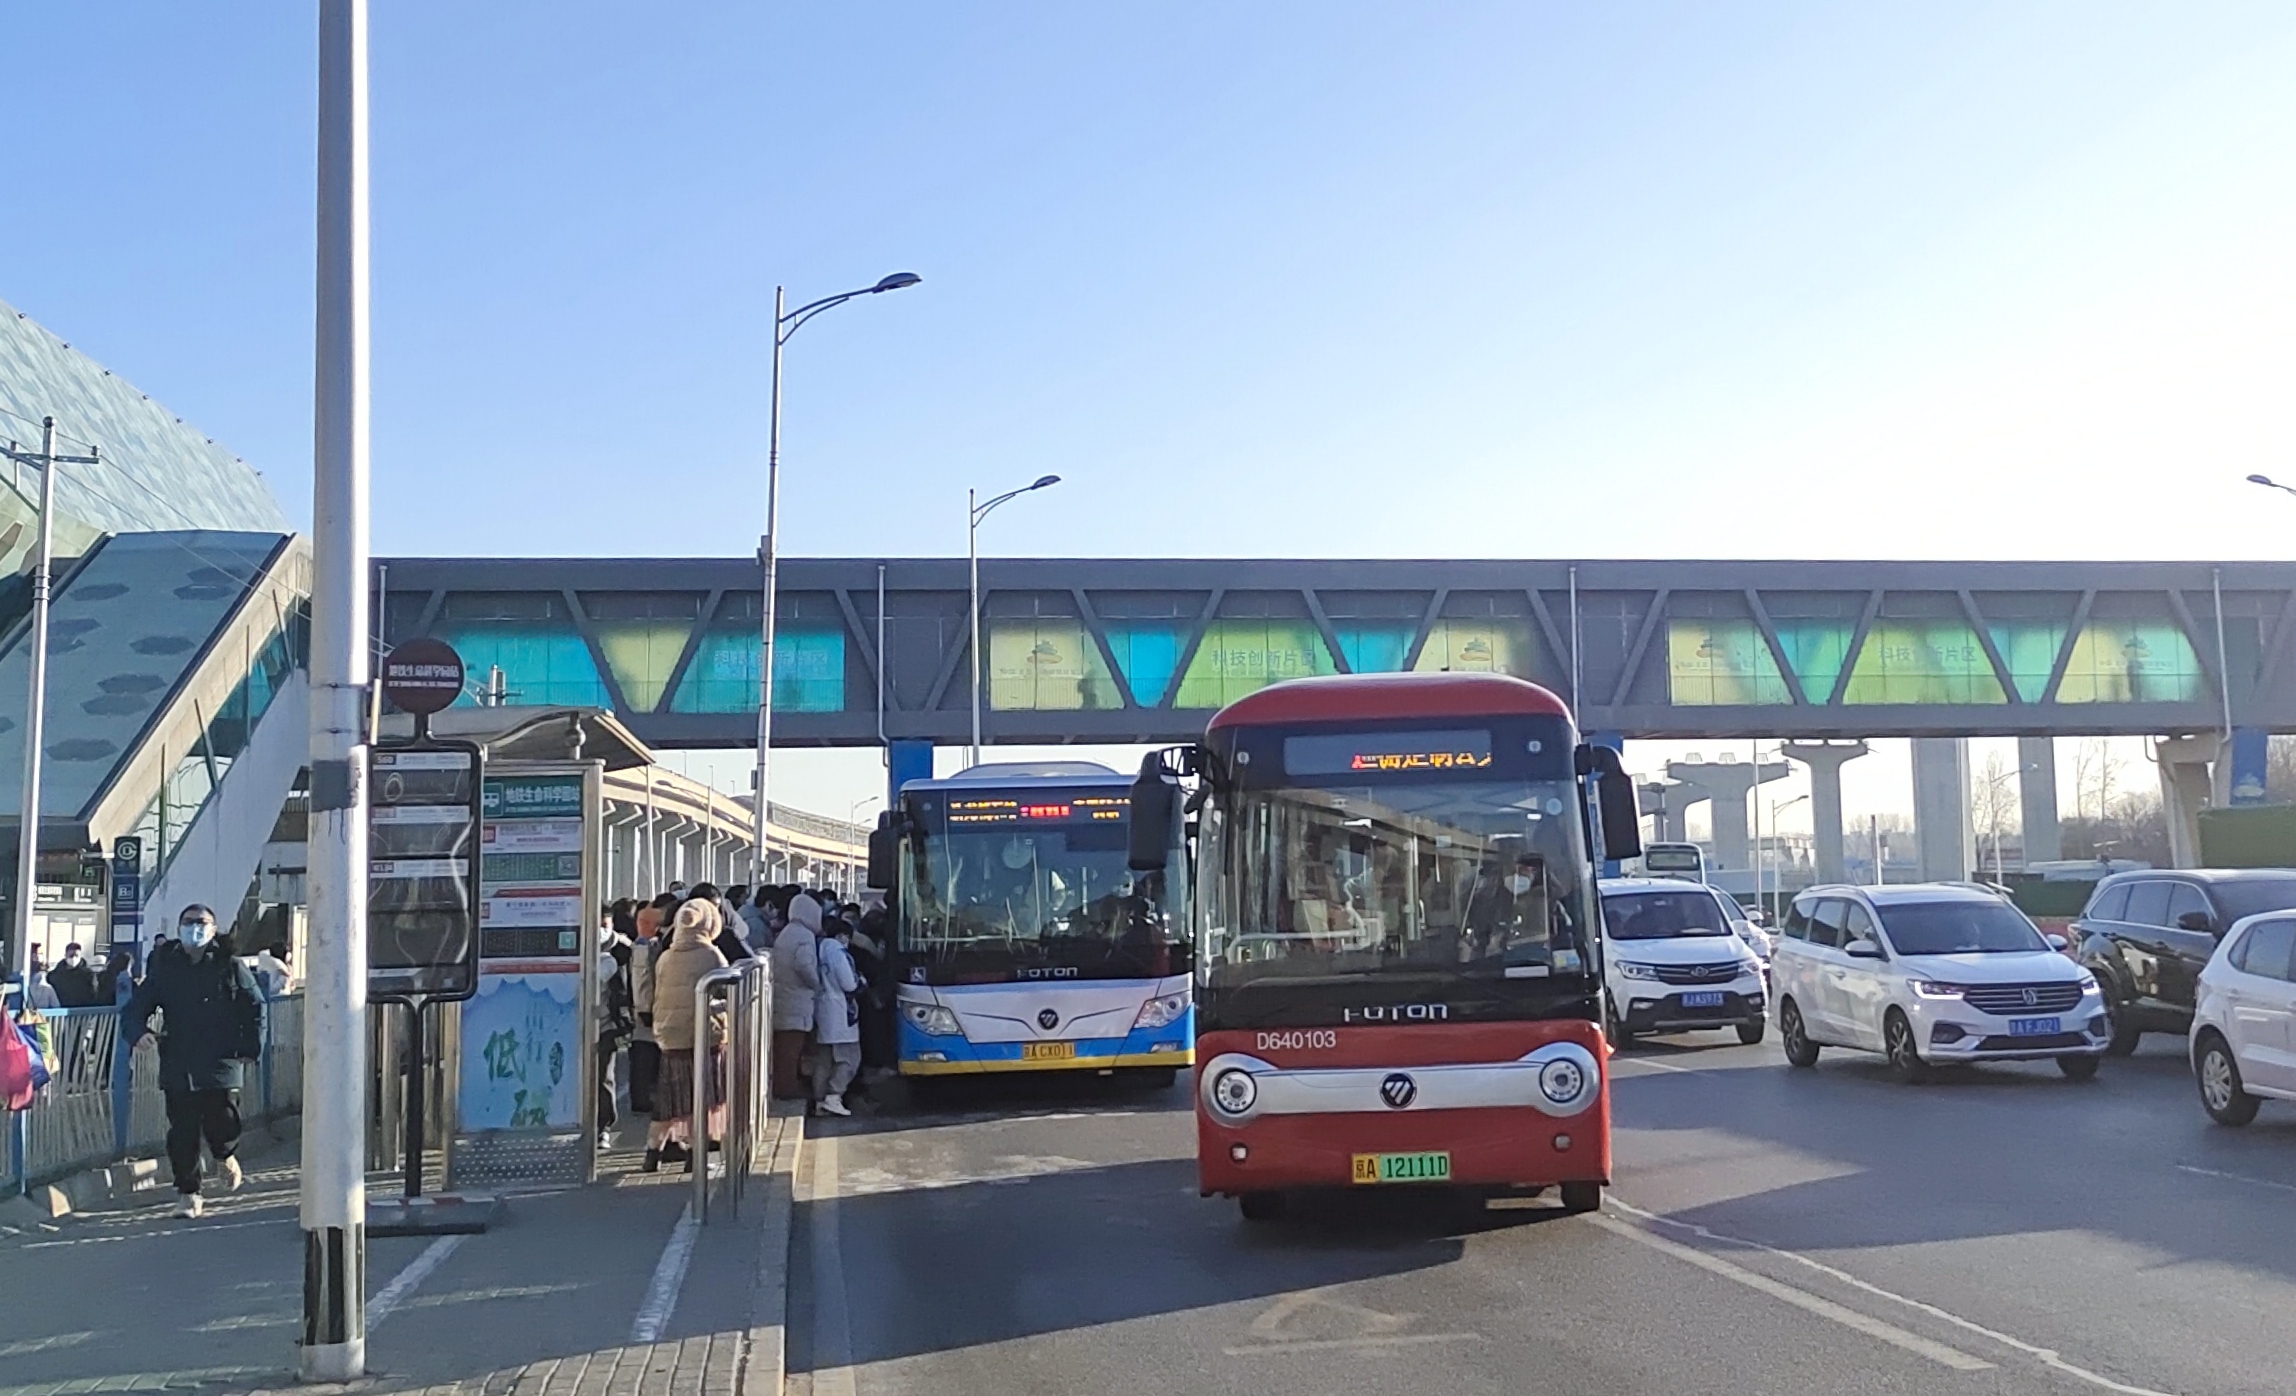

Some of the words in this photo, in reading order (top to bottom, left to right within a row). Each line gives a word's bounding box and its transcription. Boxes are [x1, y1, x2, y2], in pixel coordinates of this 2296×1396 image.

[1212, 649, 1315, 667] 科技创新片区
[1879, 646, 1977, 661] 科技新片区
[505, 785, 580, 803] 地铁生命科学园站
[2010, 1019, 2060, 1035] AFJ021
[1257, 1031, 1336, 1049] D640103
